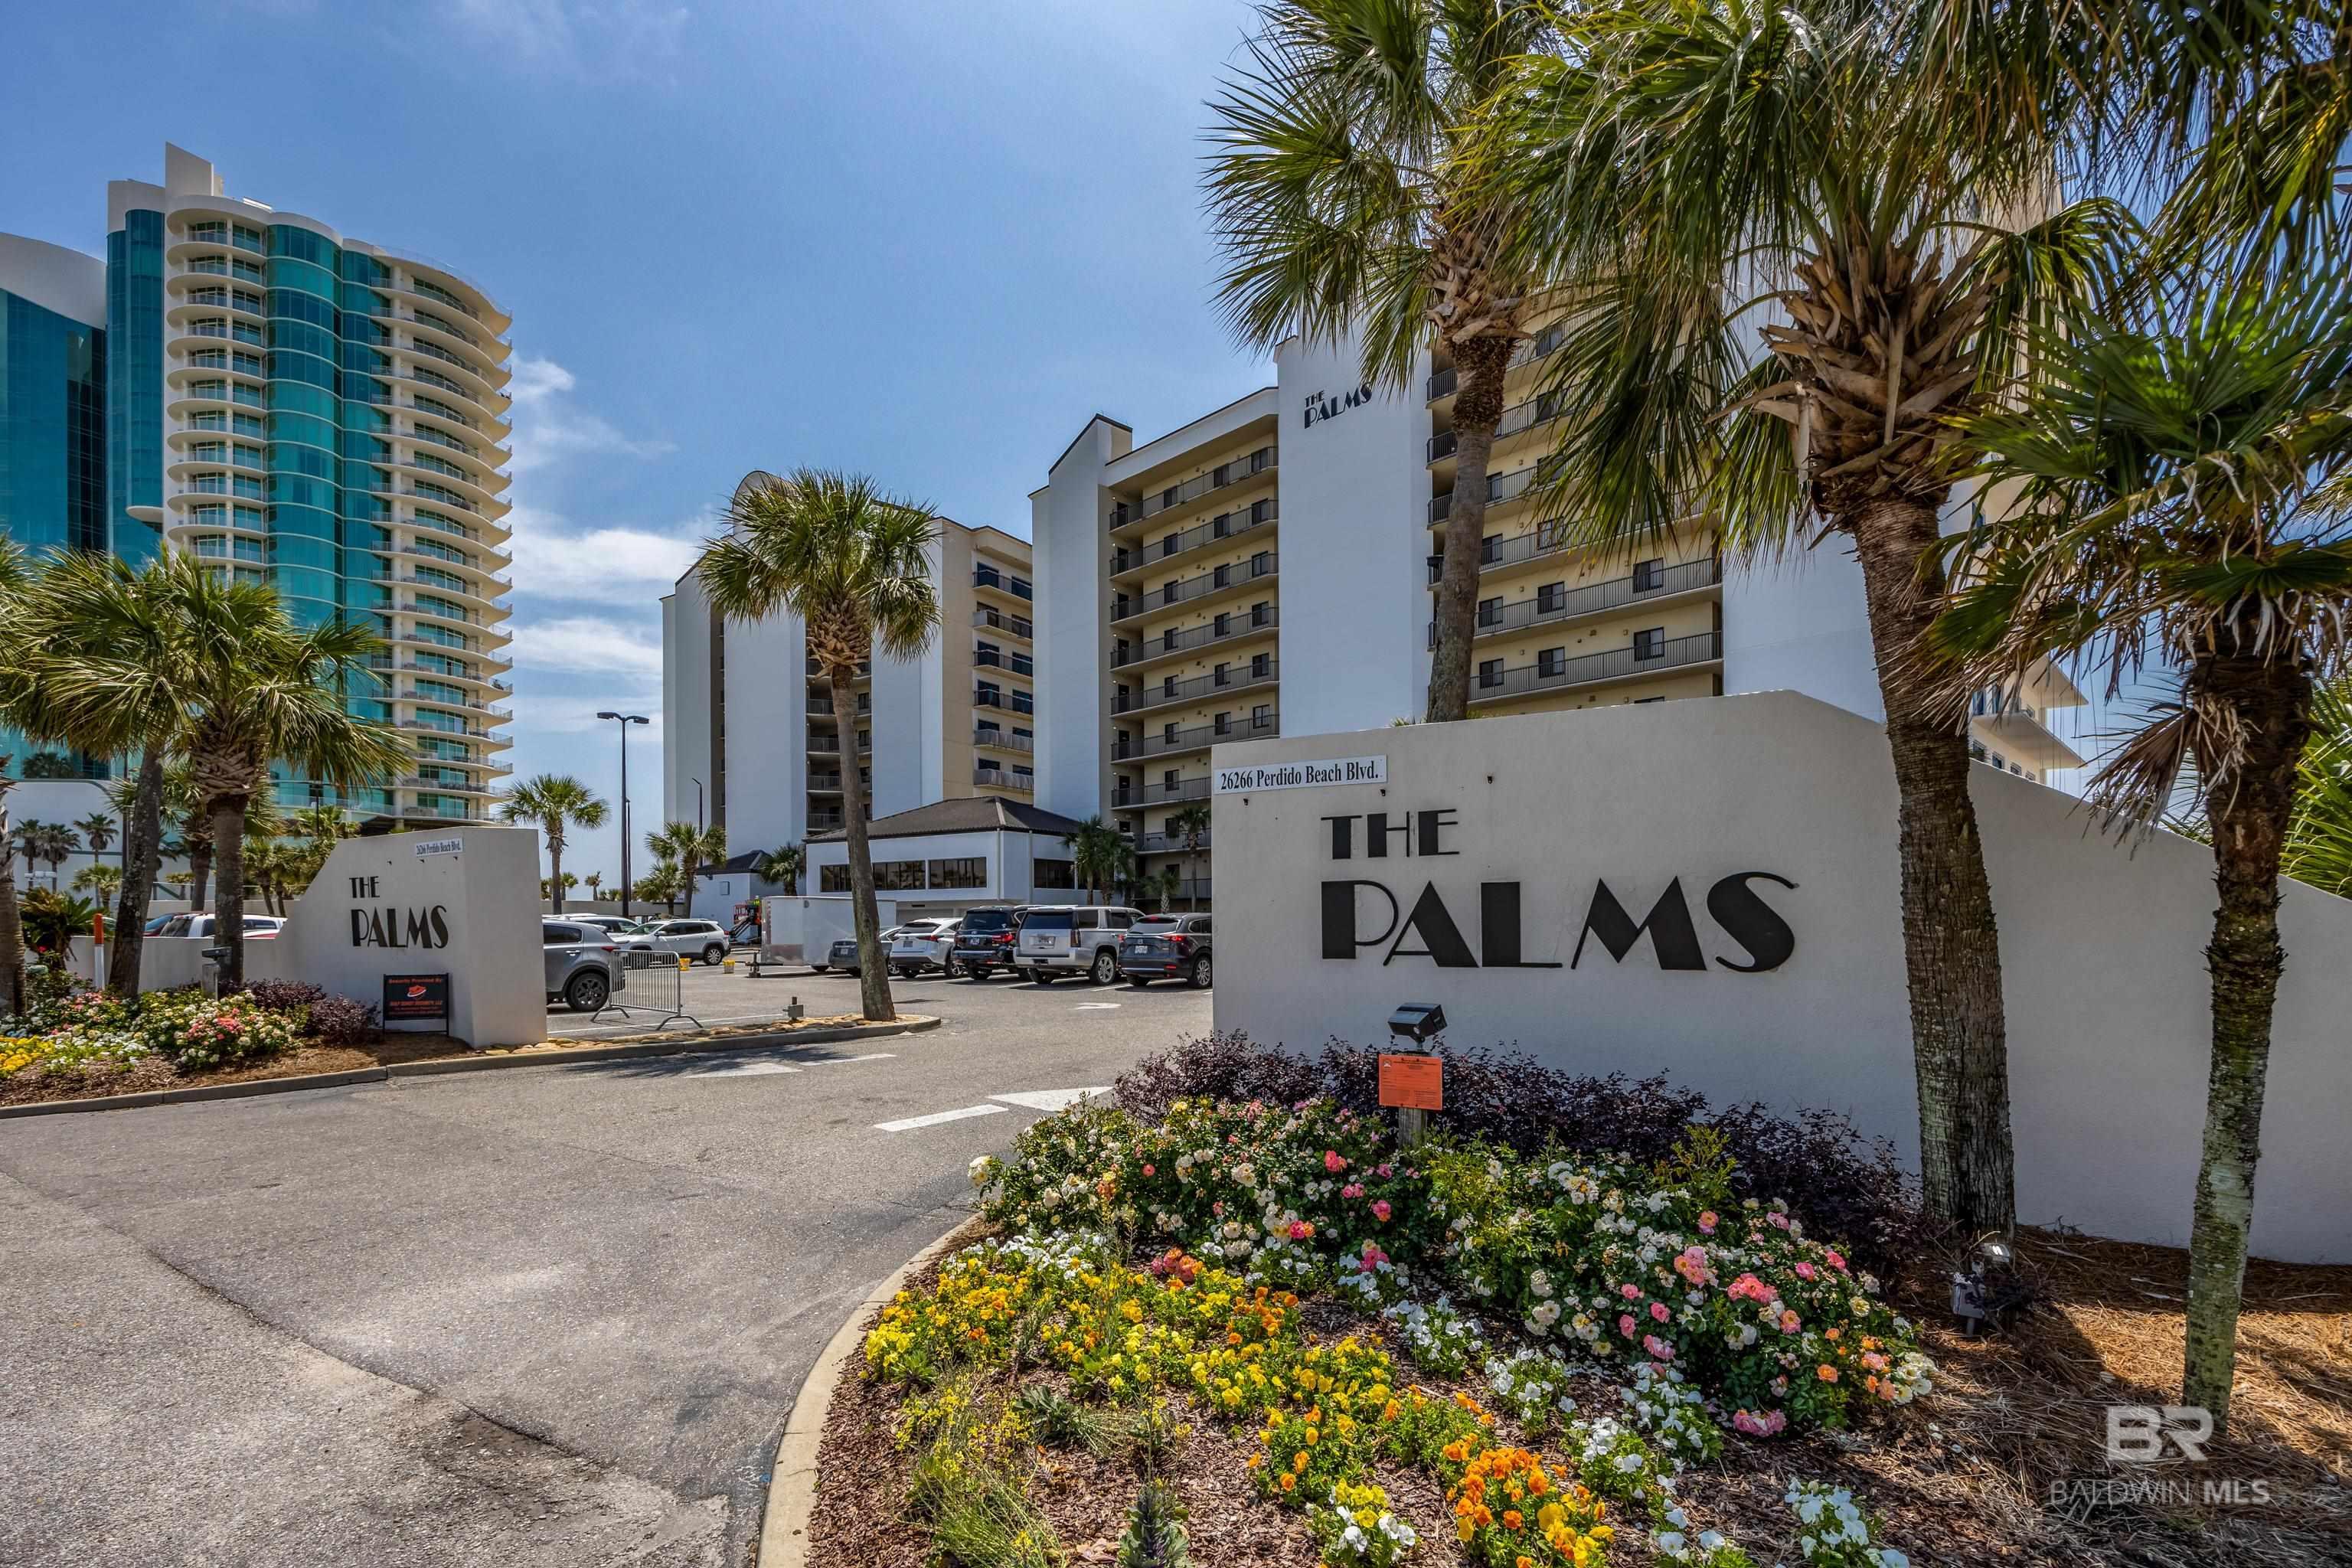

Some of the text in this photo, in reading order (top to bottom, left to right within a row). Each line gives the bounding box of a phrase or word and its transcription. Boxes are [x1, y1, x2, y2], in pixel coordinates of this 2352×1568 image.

[1304, 384, 1373, 429] PALMS
[1305, 390, 1325, 407] THE
[1220, 760, 1379, 791] 26266 Perdido Beach Blvd.
[1320, 808, 1460, 861] THE
[348, 875, 381, 899] THE
[350, 904, 449, 949] PALMS
[1321, 871, 1796, 972] PALMS
